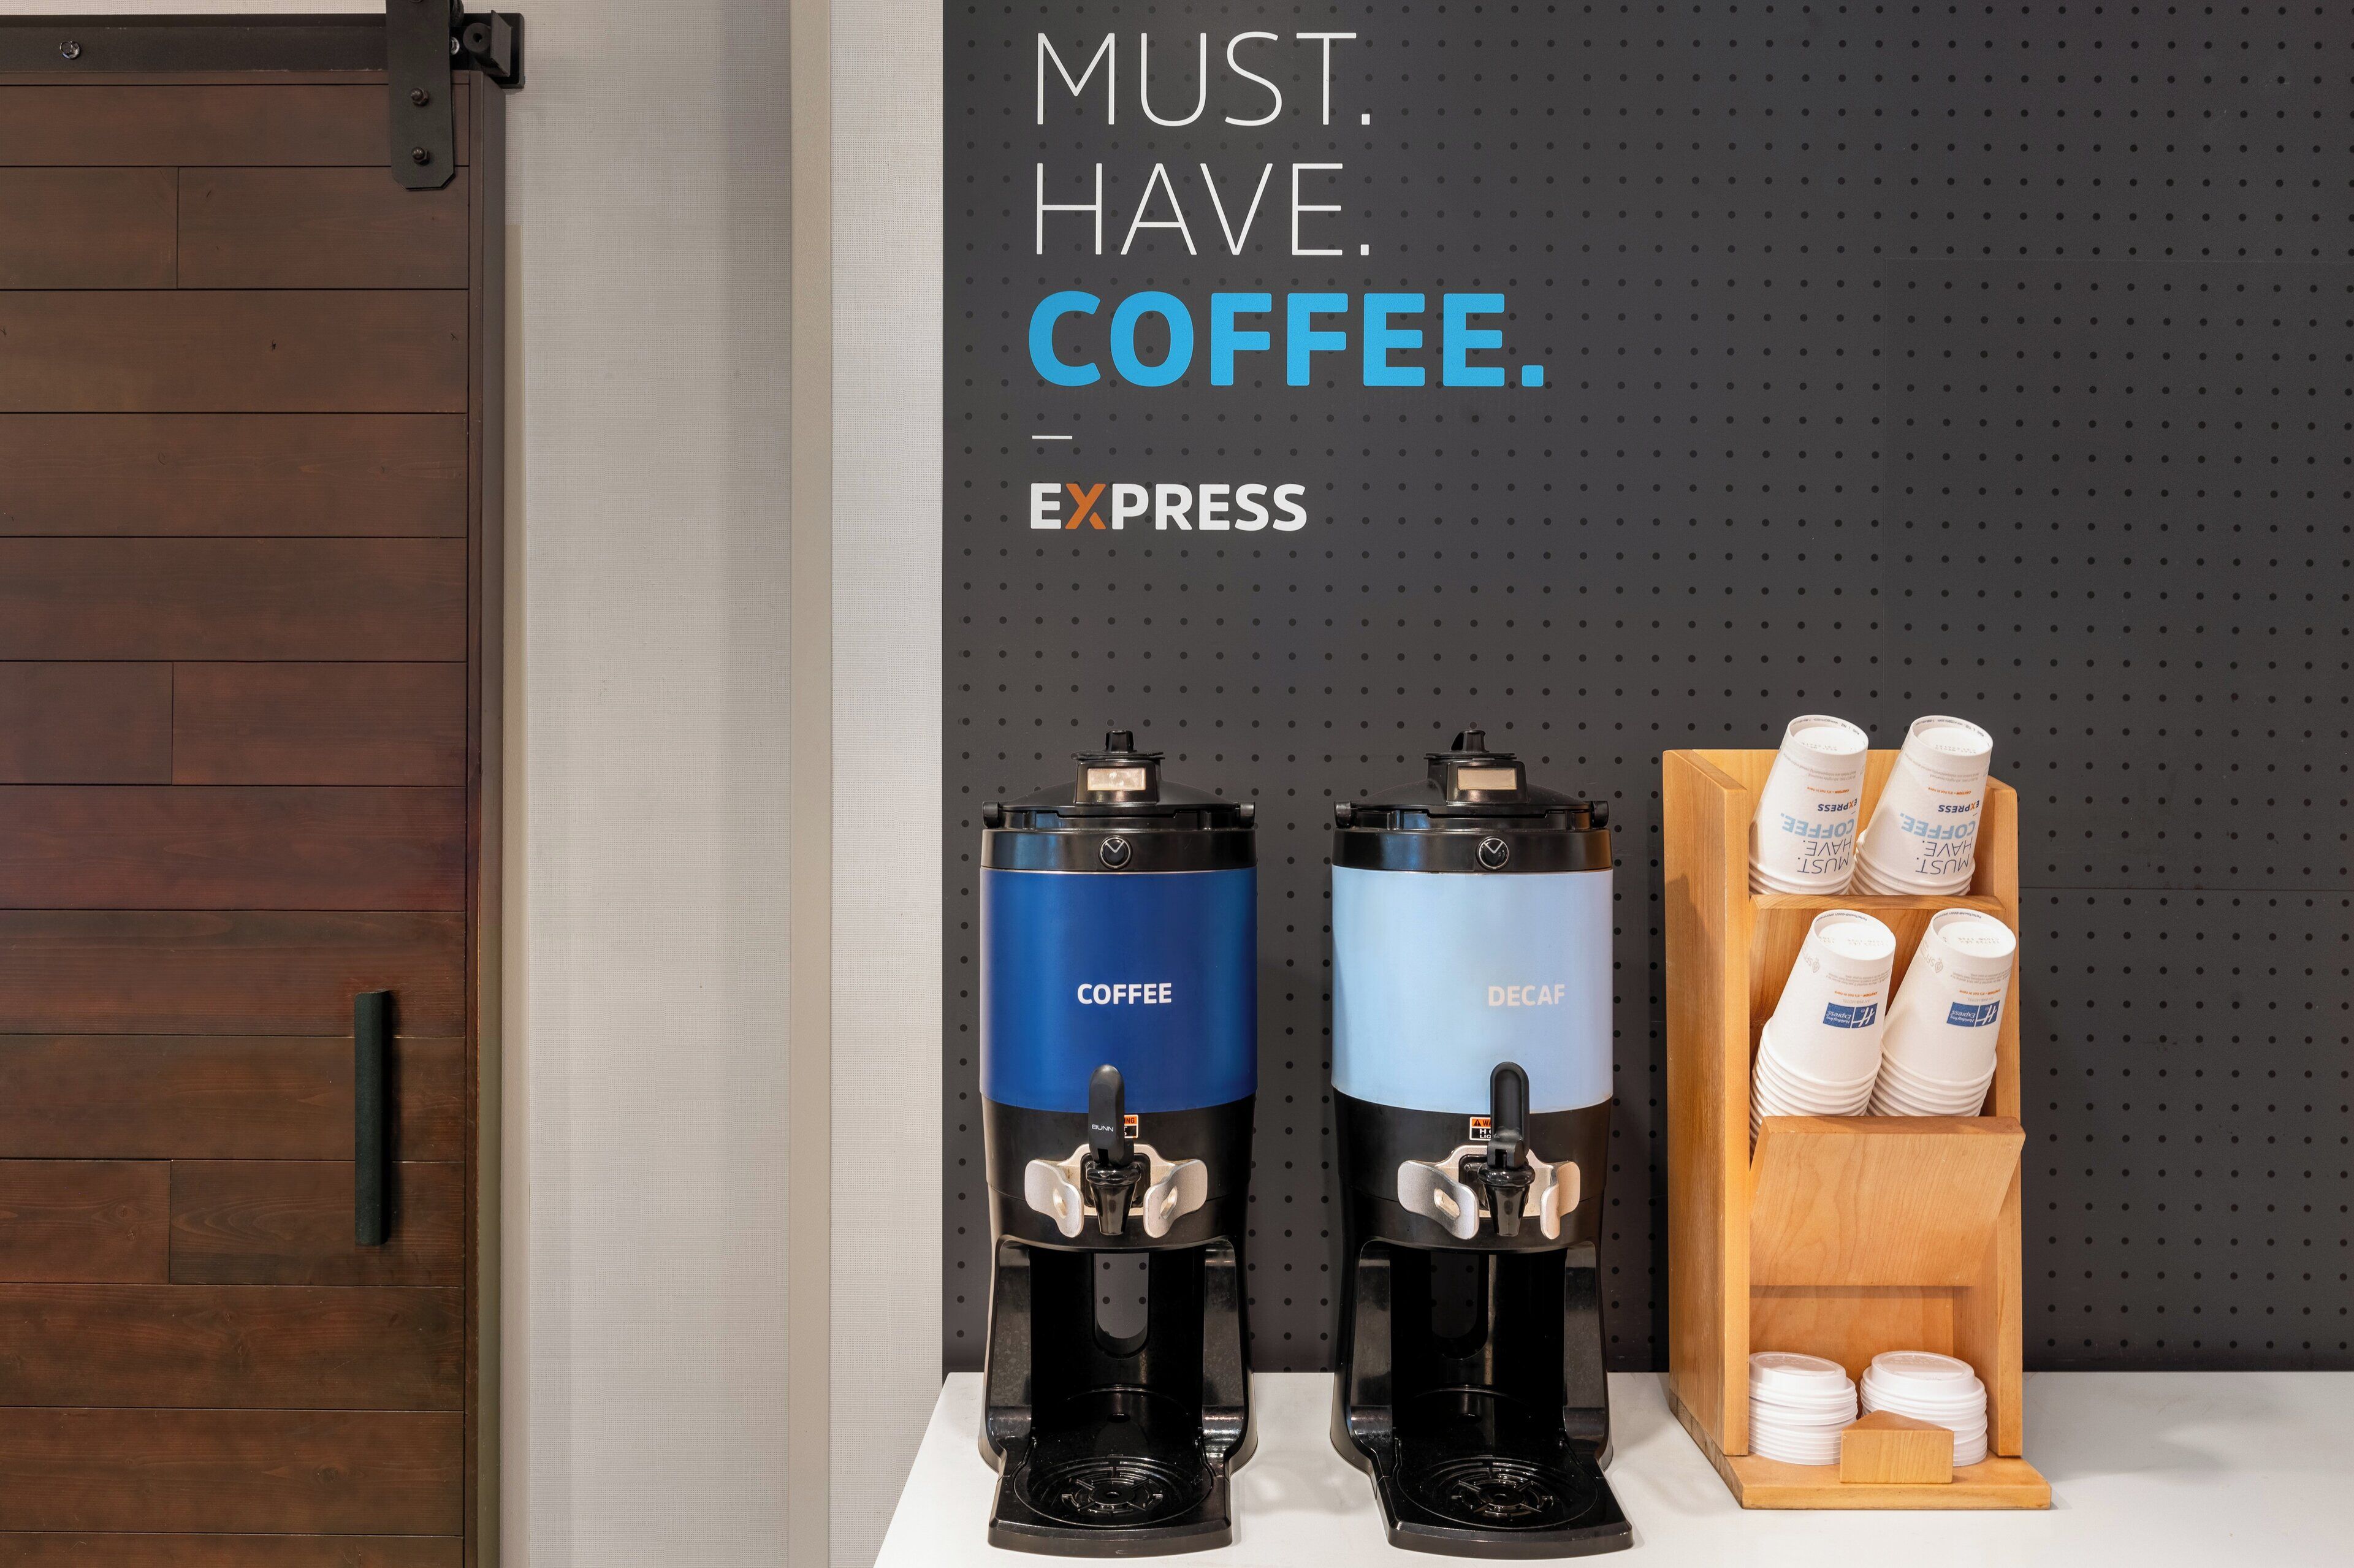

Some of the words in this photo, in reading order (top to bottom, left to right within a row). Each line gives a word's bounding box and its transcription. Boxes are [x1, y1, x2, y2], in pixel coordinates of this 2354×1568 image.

[1036, 31, 1371, 126] MUST.
[1036, 162, 1370, 256] HAVE.
[1028, 290, 1544, 387] COFFEE.
[1030, 482, 1306, 531] EXPRESS
[1818, 798, 1857, 812] EXPRESS
[1938, 800, 1979, 813] EXPRESS
[1780, 813, 1854, 839] COFFEE.
[1900, 813, 1976, 840] COFFEE.
[1803, 835, 1852, 856] HAVE.
[1922, 837, 1973, 857] HAVE.
[1797, 852, 1849, 874] MUST.
[1915, 854, 1970, 875] MUST.
[1077, 983, 1172, 1005] COFFEE
[1488, 984, 1565, 1007] DECAF
[1092, 1124, 1114, 1132] BUNN
